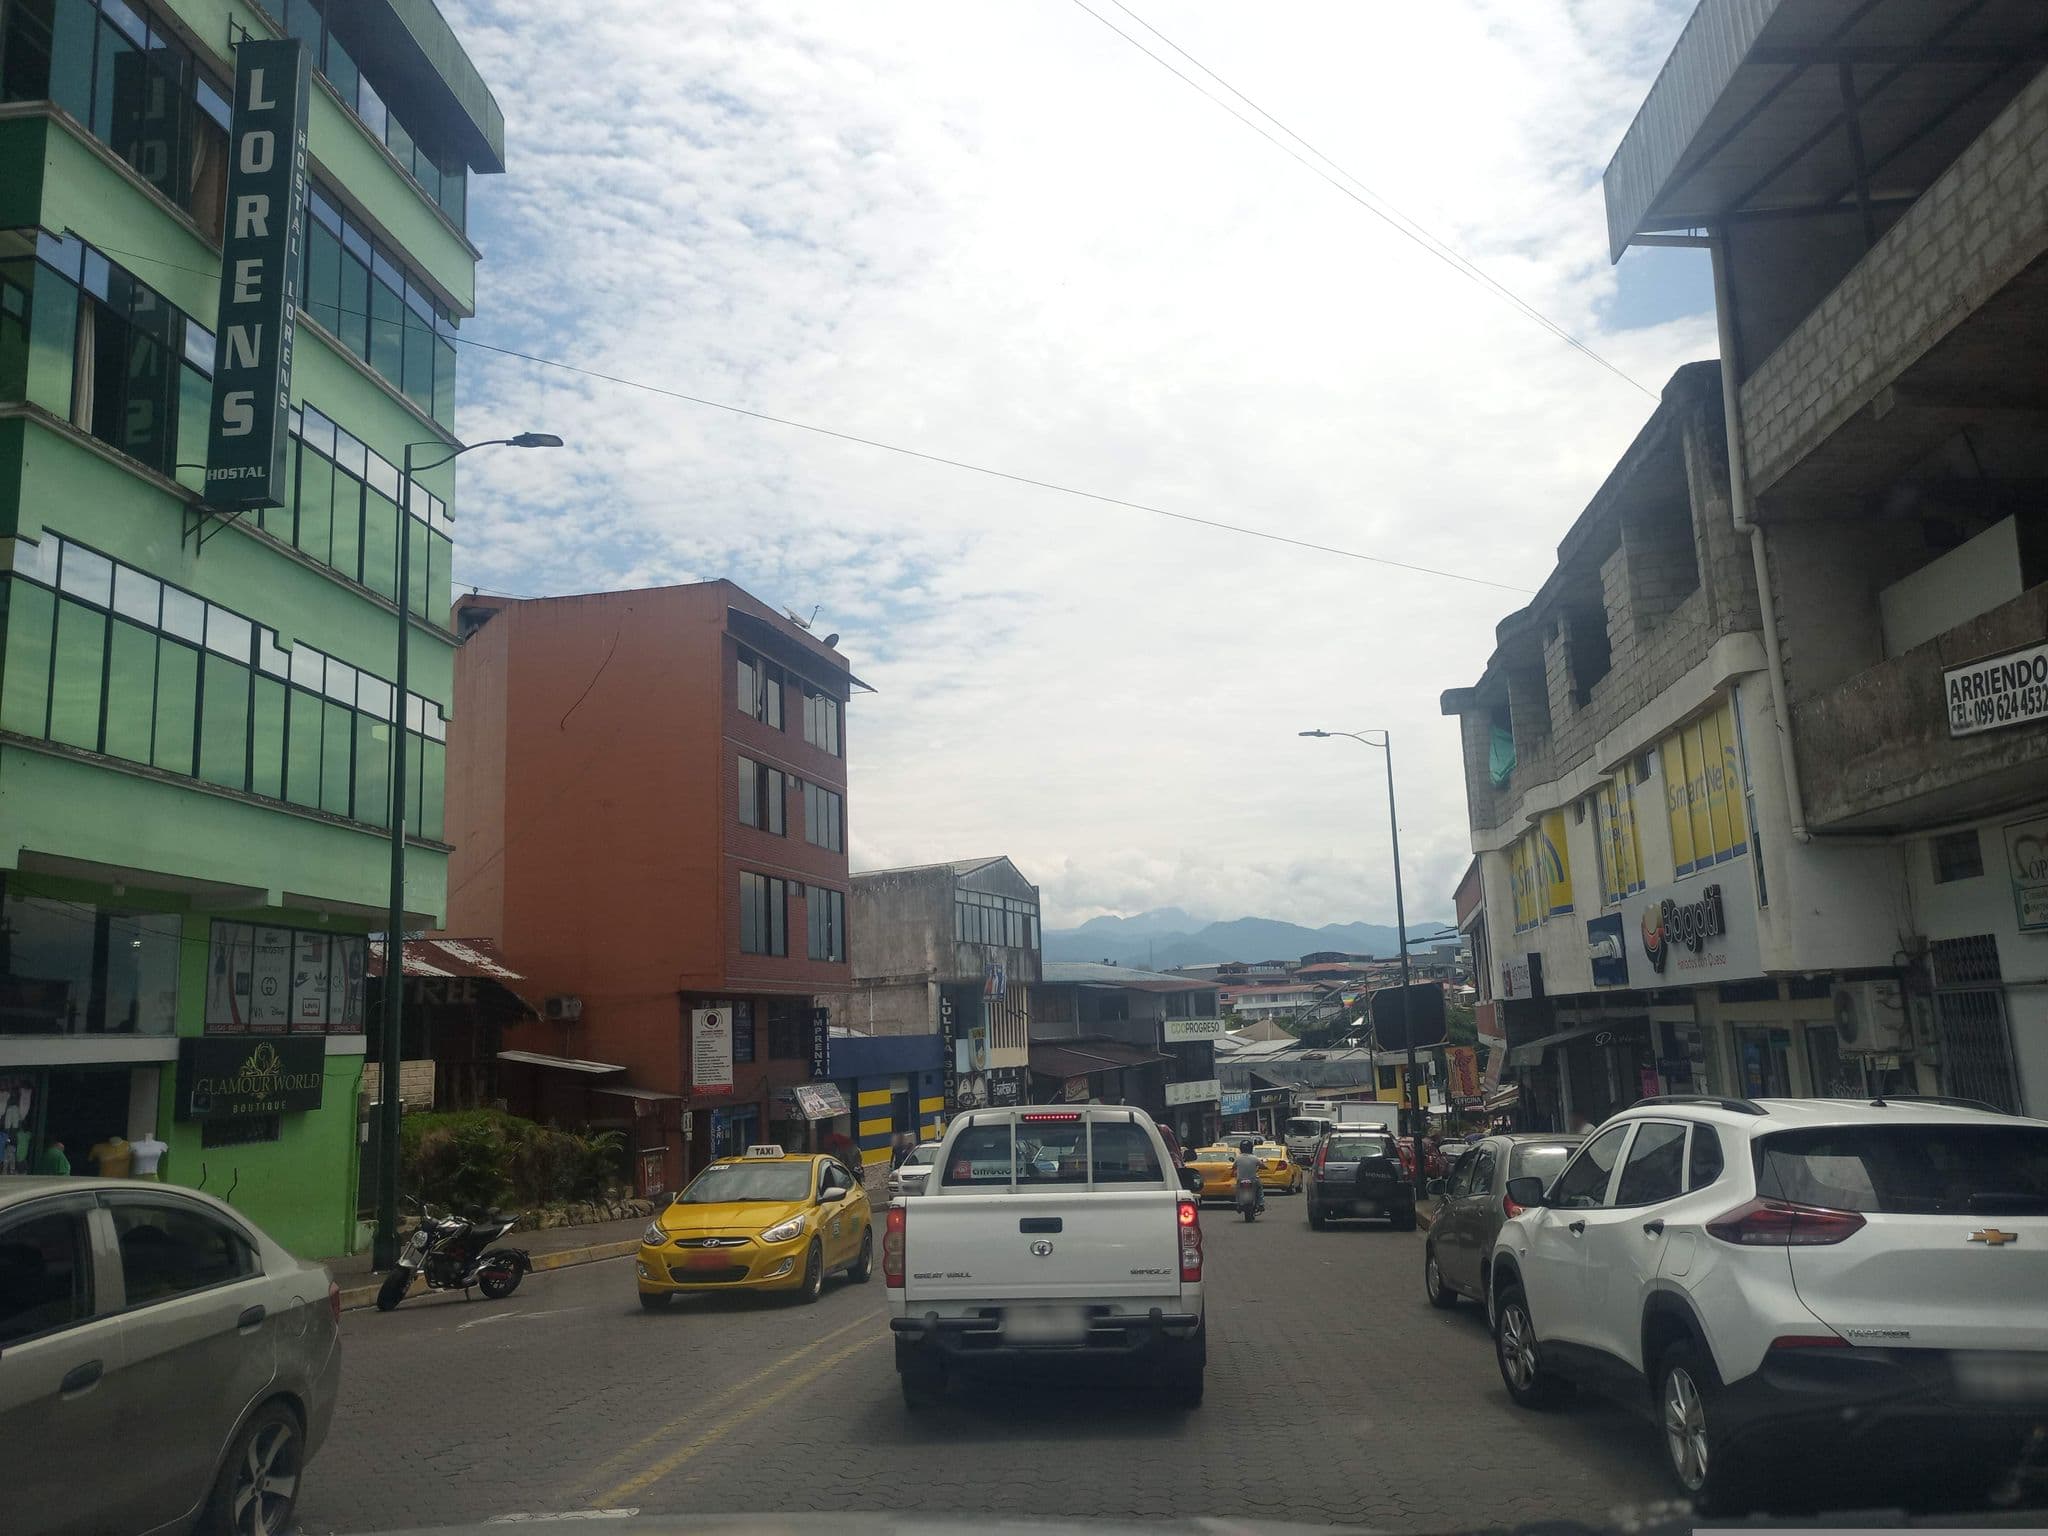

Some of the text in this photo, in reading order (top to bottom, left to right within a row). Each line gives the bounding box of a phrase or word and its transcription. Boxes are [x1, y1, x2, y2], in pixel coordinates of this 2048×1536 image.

[222, 68, 276, 437] LORENS
[279, 130, 307, 410] HOSTAL LORENS
[206, 466, 266, 481] HOSTAL
[1950, 655, 2048, 704] ARRIENDO
[1974, 697, 1995, 725] 099
[1997, 692, 2018, 721] 624
[814, 1010, 823, 1076] IMPRENTA
[197, 1073, 320, 1096] GLAMOUR WORLD
[232, 1100, 288, 1114] BOUTIQUE
[755, 1147, 774, 1156] TAXI
[1846, 1328, 1912, 1339] TRACKER
